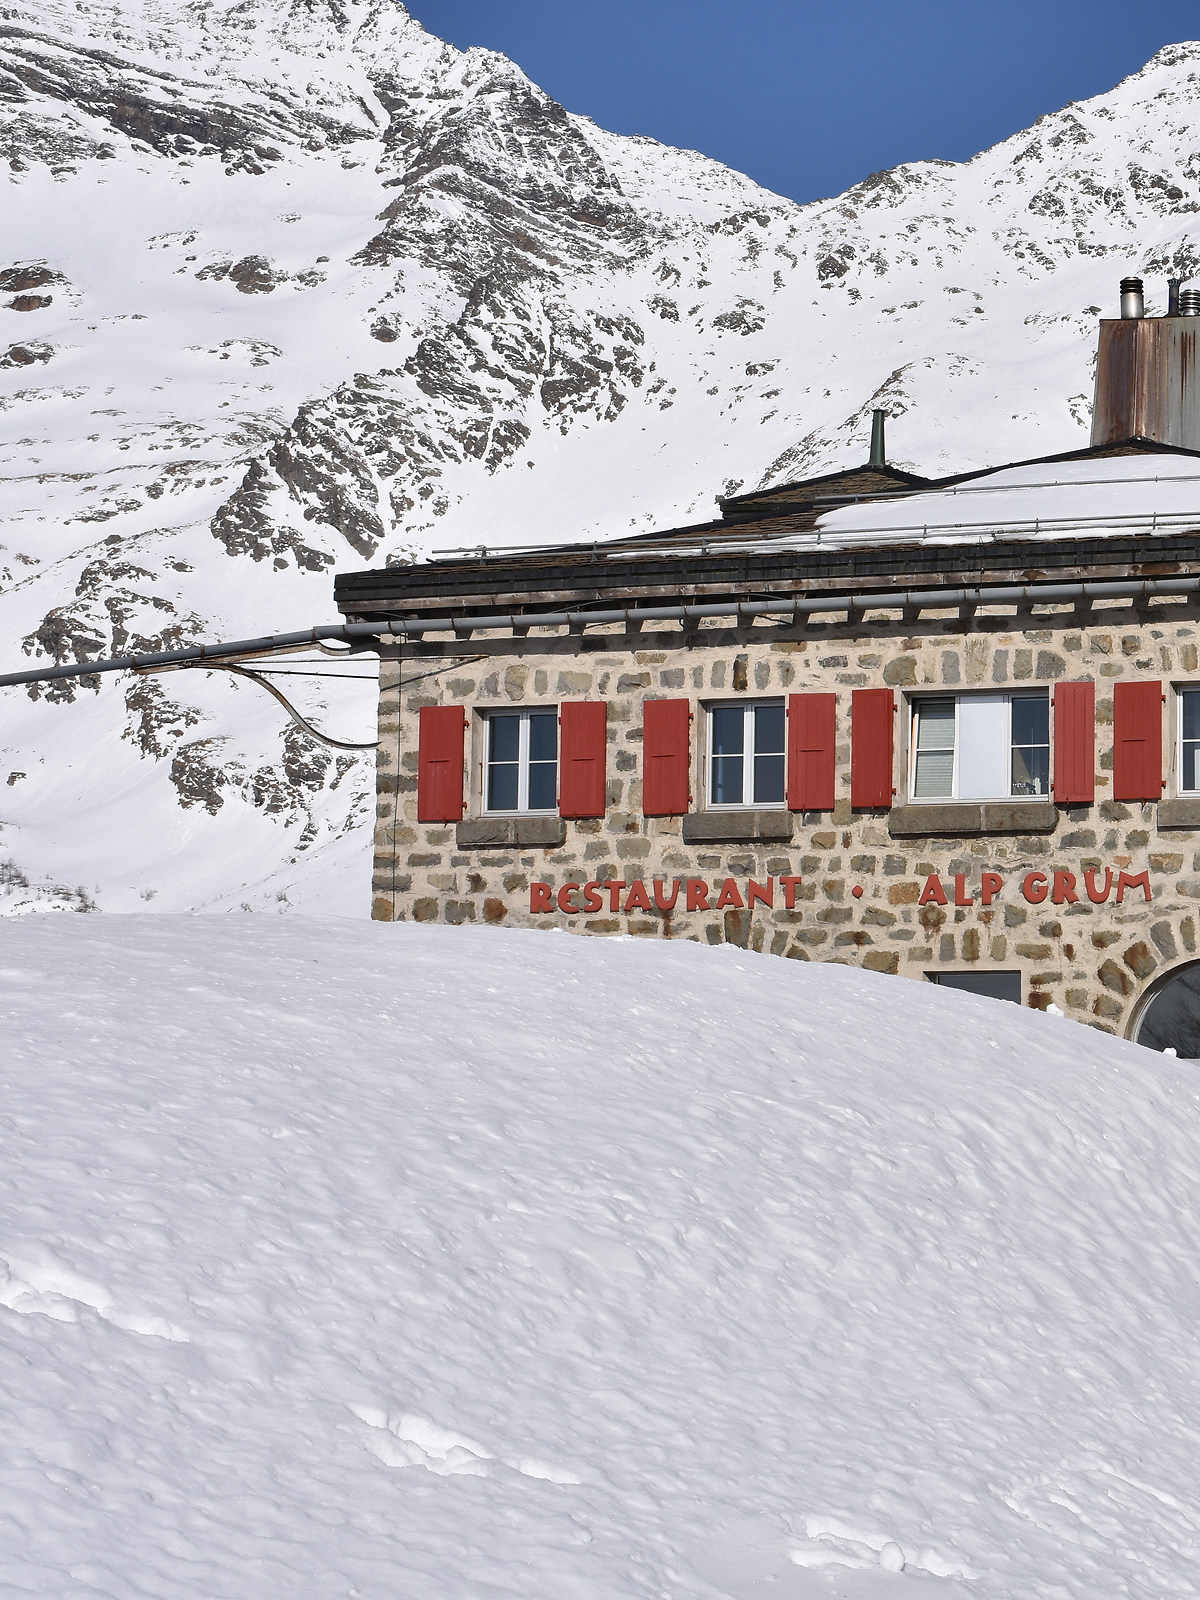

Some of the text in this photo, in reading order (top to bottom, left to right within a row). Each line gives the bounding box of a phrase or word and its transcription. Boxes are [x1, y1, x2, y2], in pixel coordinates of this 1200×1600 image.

[530, 876, 801, 913] RESTAURANT
[918, 874, 1003, 906] ALP
[1023, 866, 1152, 903] GRÜM
